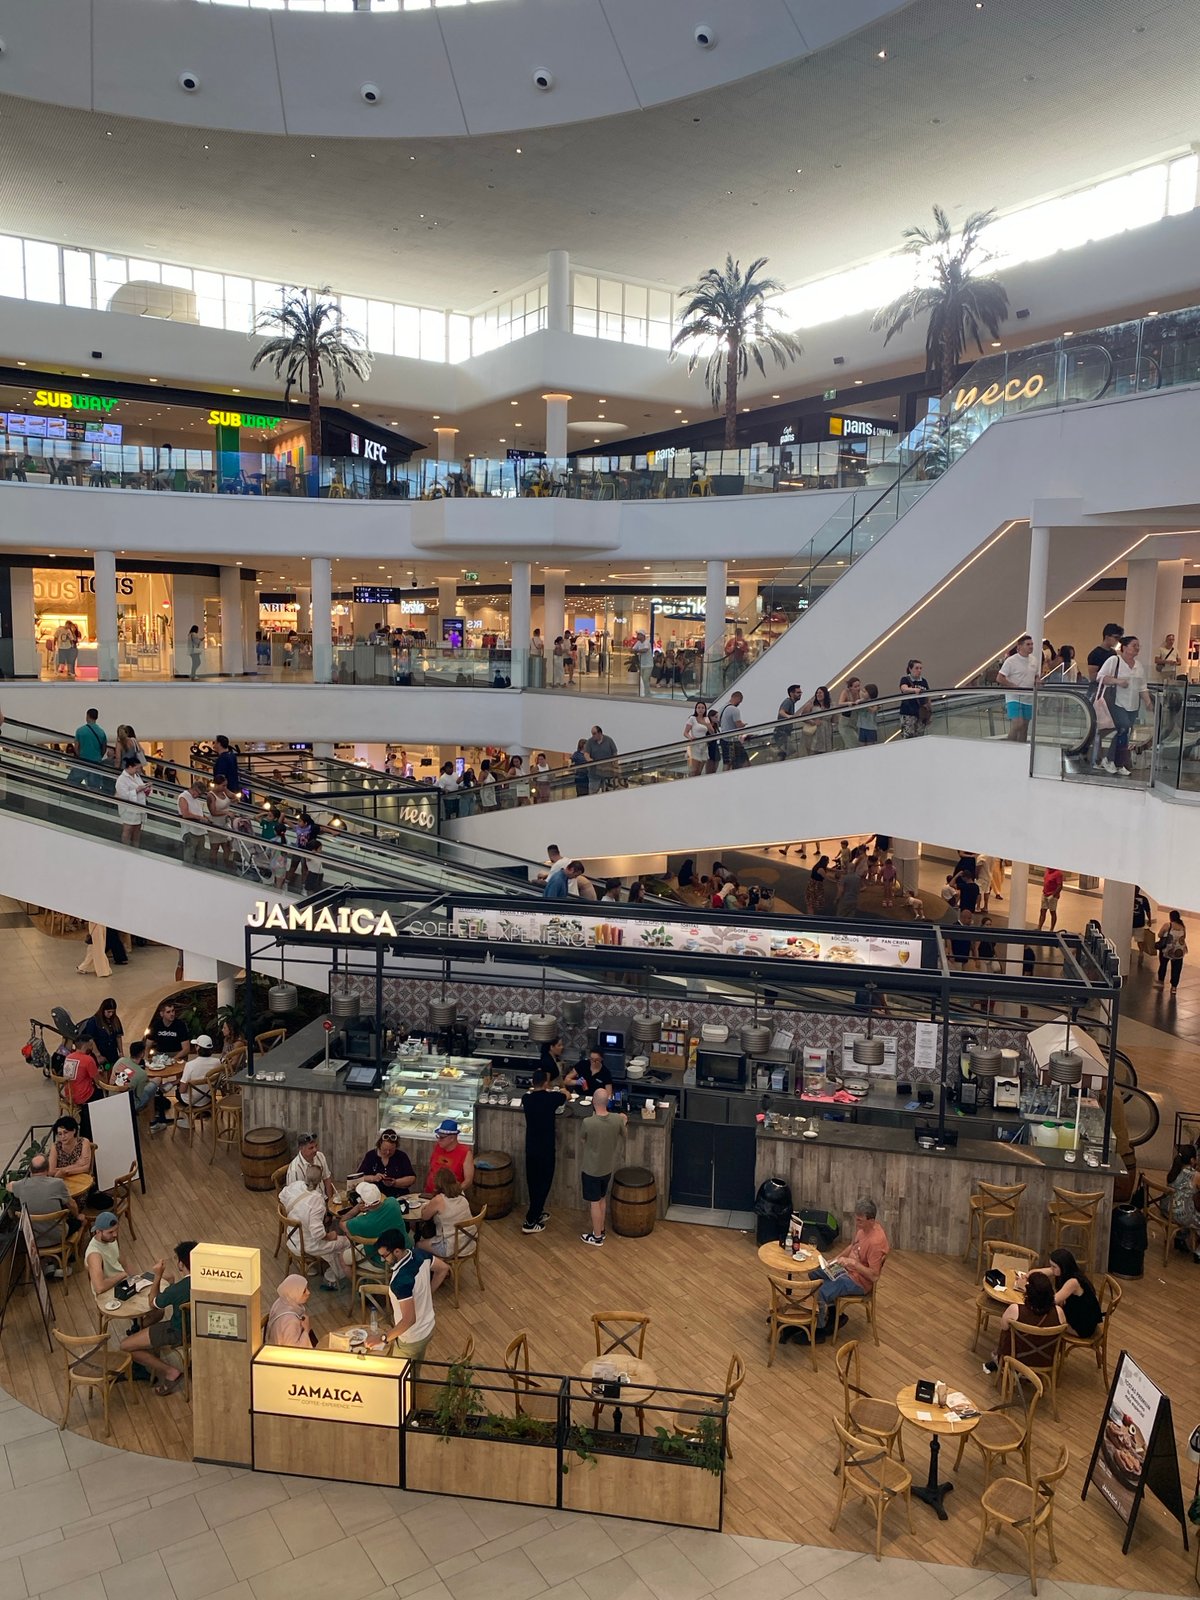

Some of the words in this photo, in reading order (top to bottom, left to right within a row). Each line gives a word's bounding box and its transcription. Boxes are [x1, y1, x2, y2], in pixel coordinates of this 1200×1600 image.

[33, 390, 118, 412] SUBWAY
[955, 374, 1044, 411] neco
[207, 410, 281, 430] SUBWAY
[844, 419, 873, 436] pans
[364, 438, 387, 465] KFC
[76, 575, 133, 595] TS
[400, 806, 435, 829] neco
[247, 901, 399, 937] JAMAICA
[409, 920, 479, 939] COFFEE
[487, 928, 596, 948] EXPERIENCE
[200, 1268, 243, 1280] JAMAICA
[288, 1384, 363, 1403] JAMAICA
